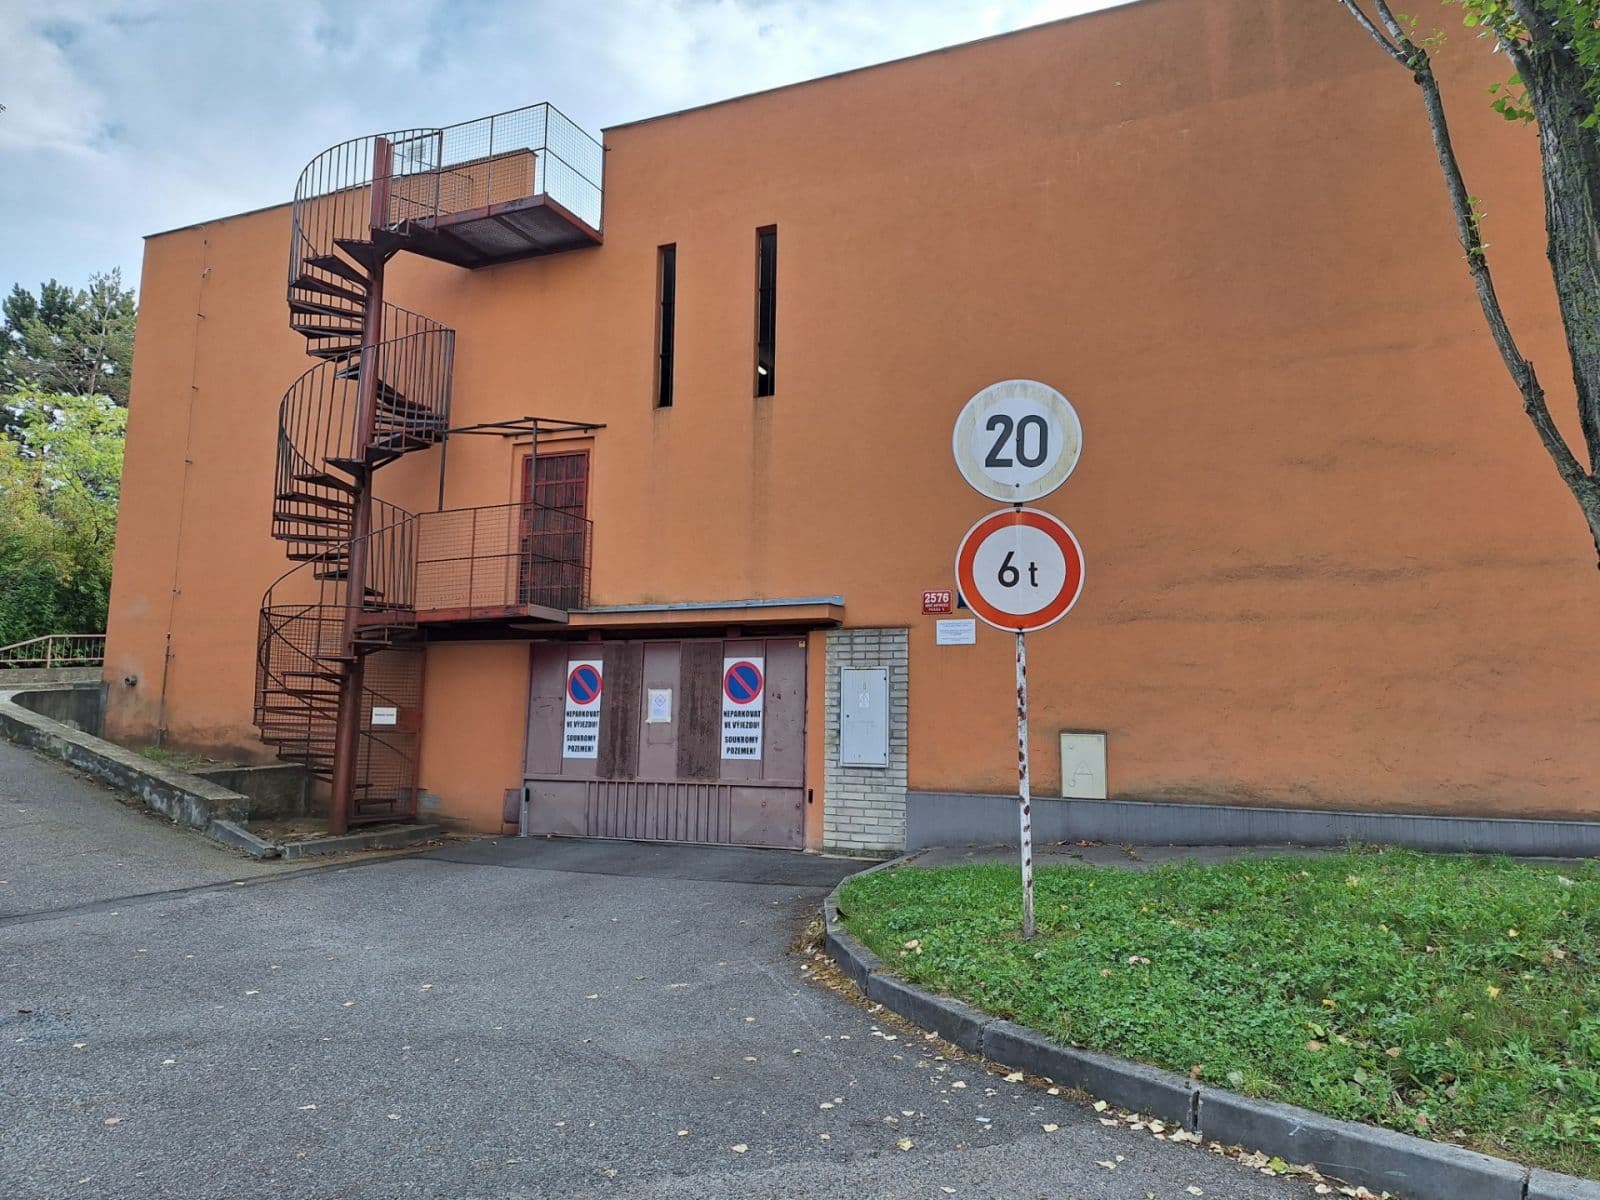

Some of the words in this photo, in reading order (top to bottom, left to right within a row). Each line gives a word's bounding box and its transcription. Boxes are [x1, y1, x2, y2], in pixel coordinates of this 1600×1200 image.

[985, 414, 1048, 468] 20
[998, 551, 1020, 588] 6
[1028, 561, 1039, 588] t
[924, 592, 949, 604] 2576
[566, 710, 600, 718] NEPARKOVAT
[724, 710, 761, 718] NEPARKOVAT
[567, 745, 594, 753] POZEMEK!
[726, 747, 757, 755] POZEMEK!
